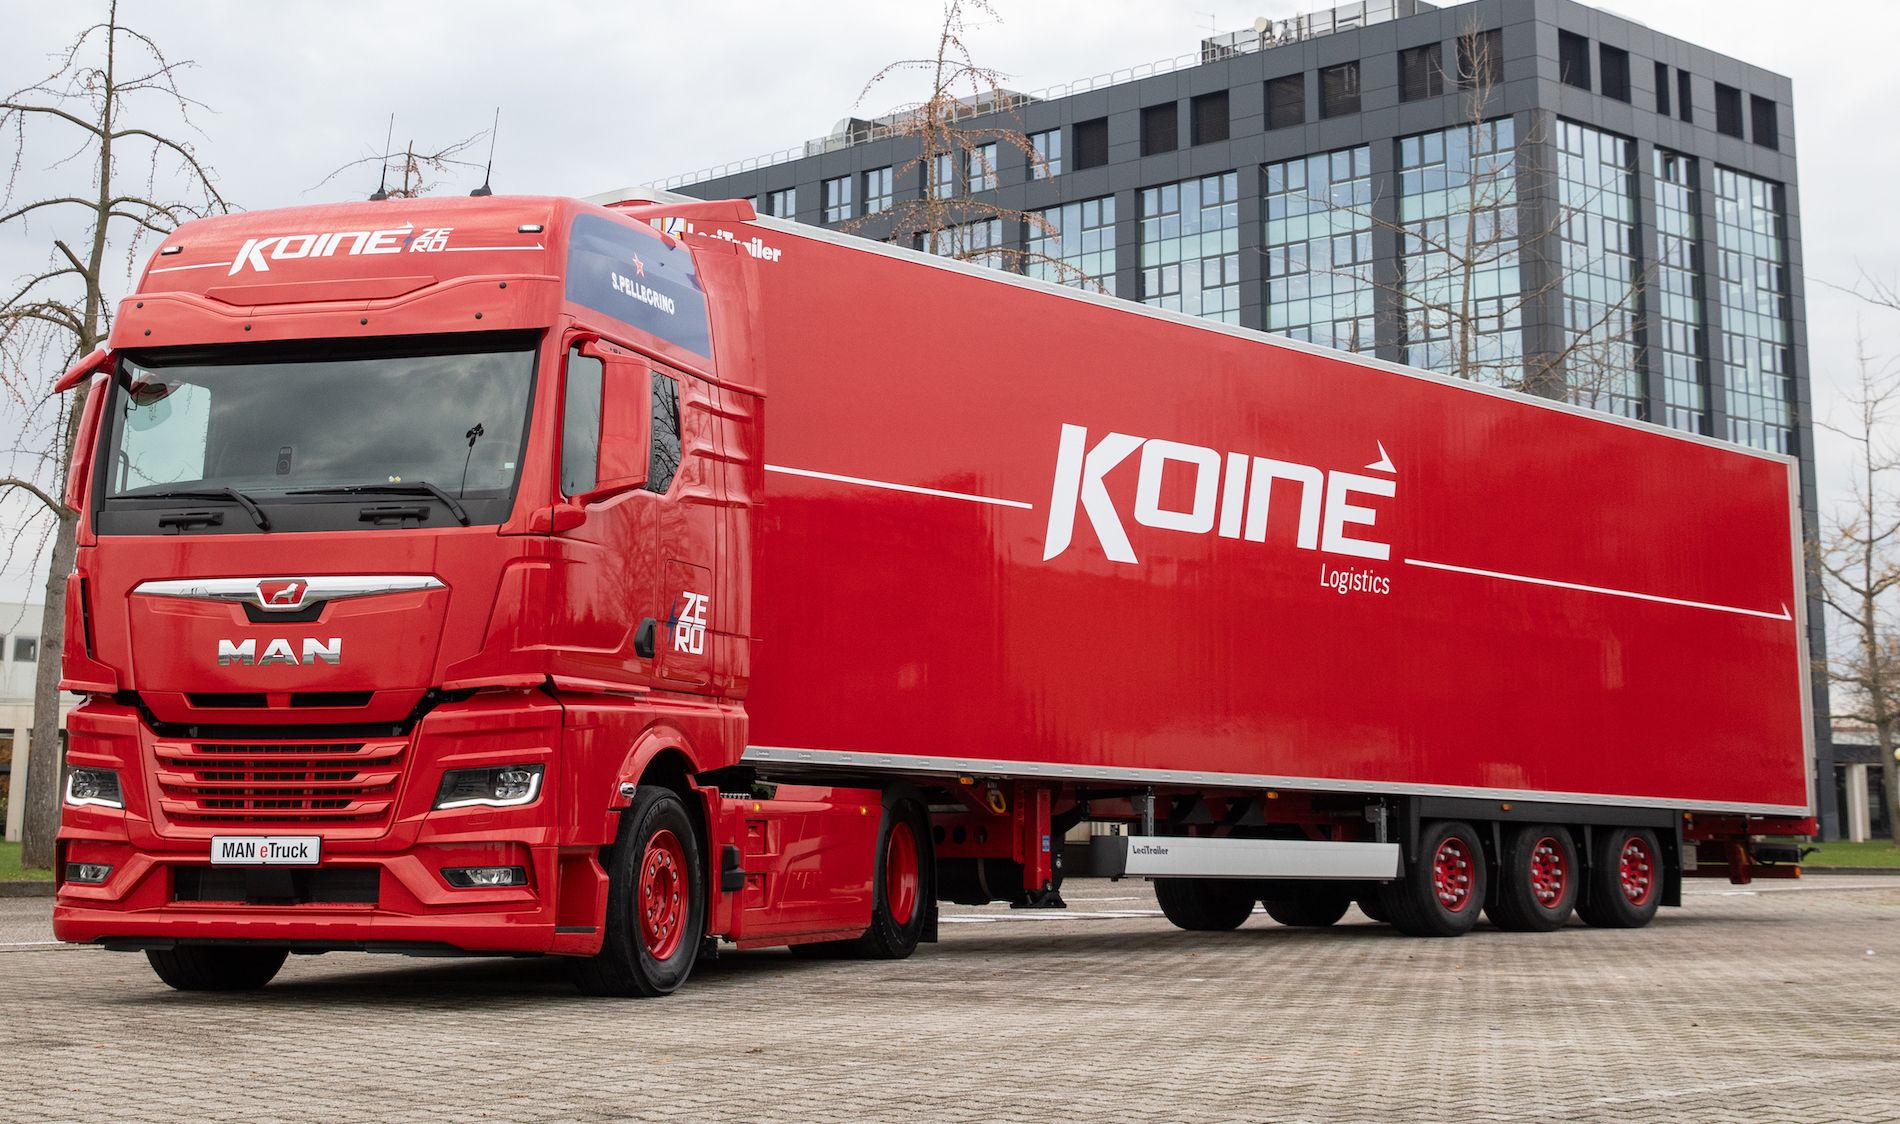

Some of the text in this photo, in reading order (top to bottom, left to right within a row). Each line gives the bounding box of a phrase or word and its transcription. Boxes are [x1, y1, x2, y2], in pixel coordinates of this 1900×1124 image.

[422, 228, 454, 239] ZE
[409, 239, 448, 252] RO
[611, 271, 675, 315] S.PELLEGRINO
[1320, 563, 1390, 594] Logistics
[218, 638, 342, 665] MAN
[222, 842, 308, 858] MAN eTruck
[1132, 845, 1169, 855] LeciTrailer
